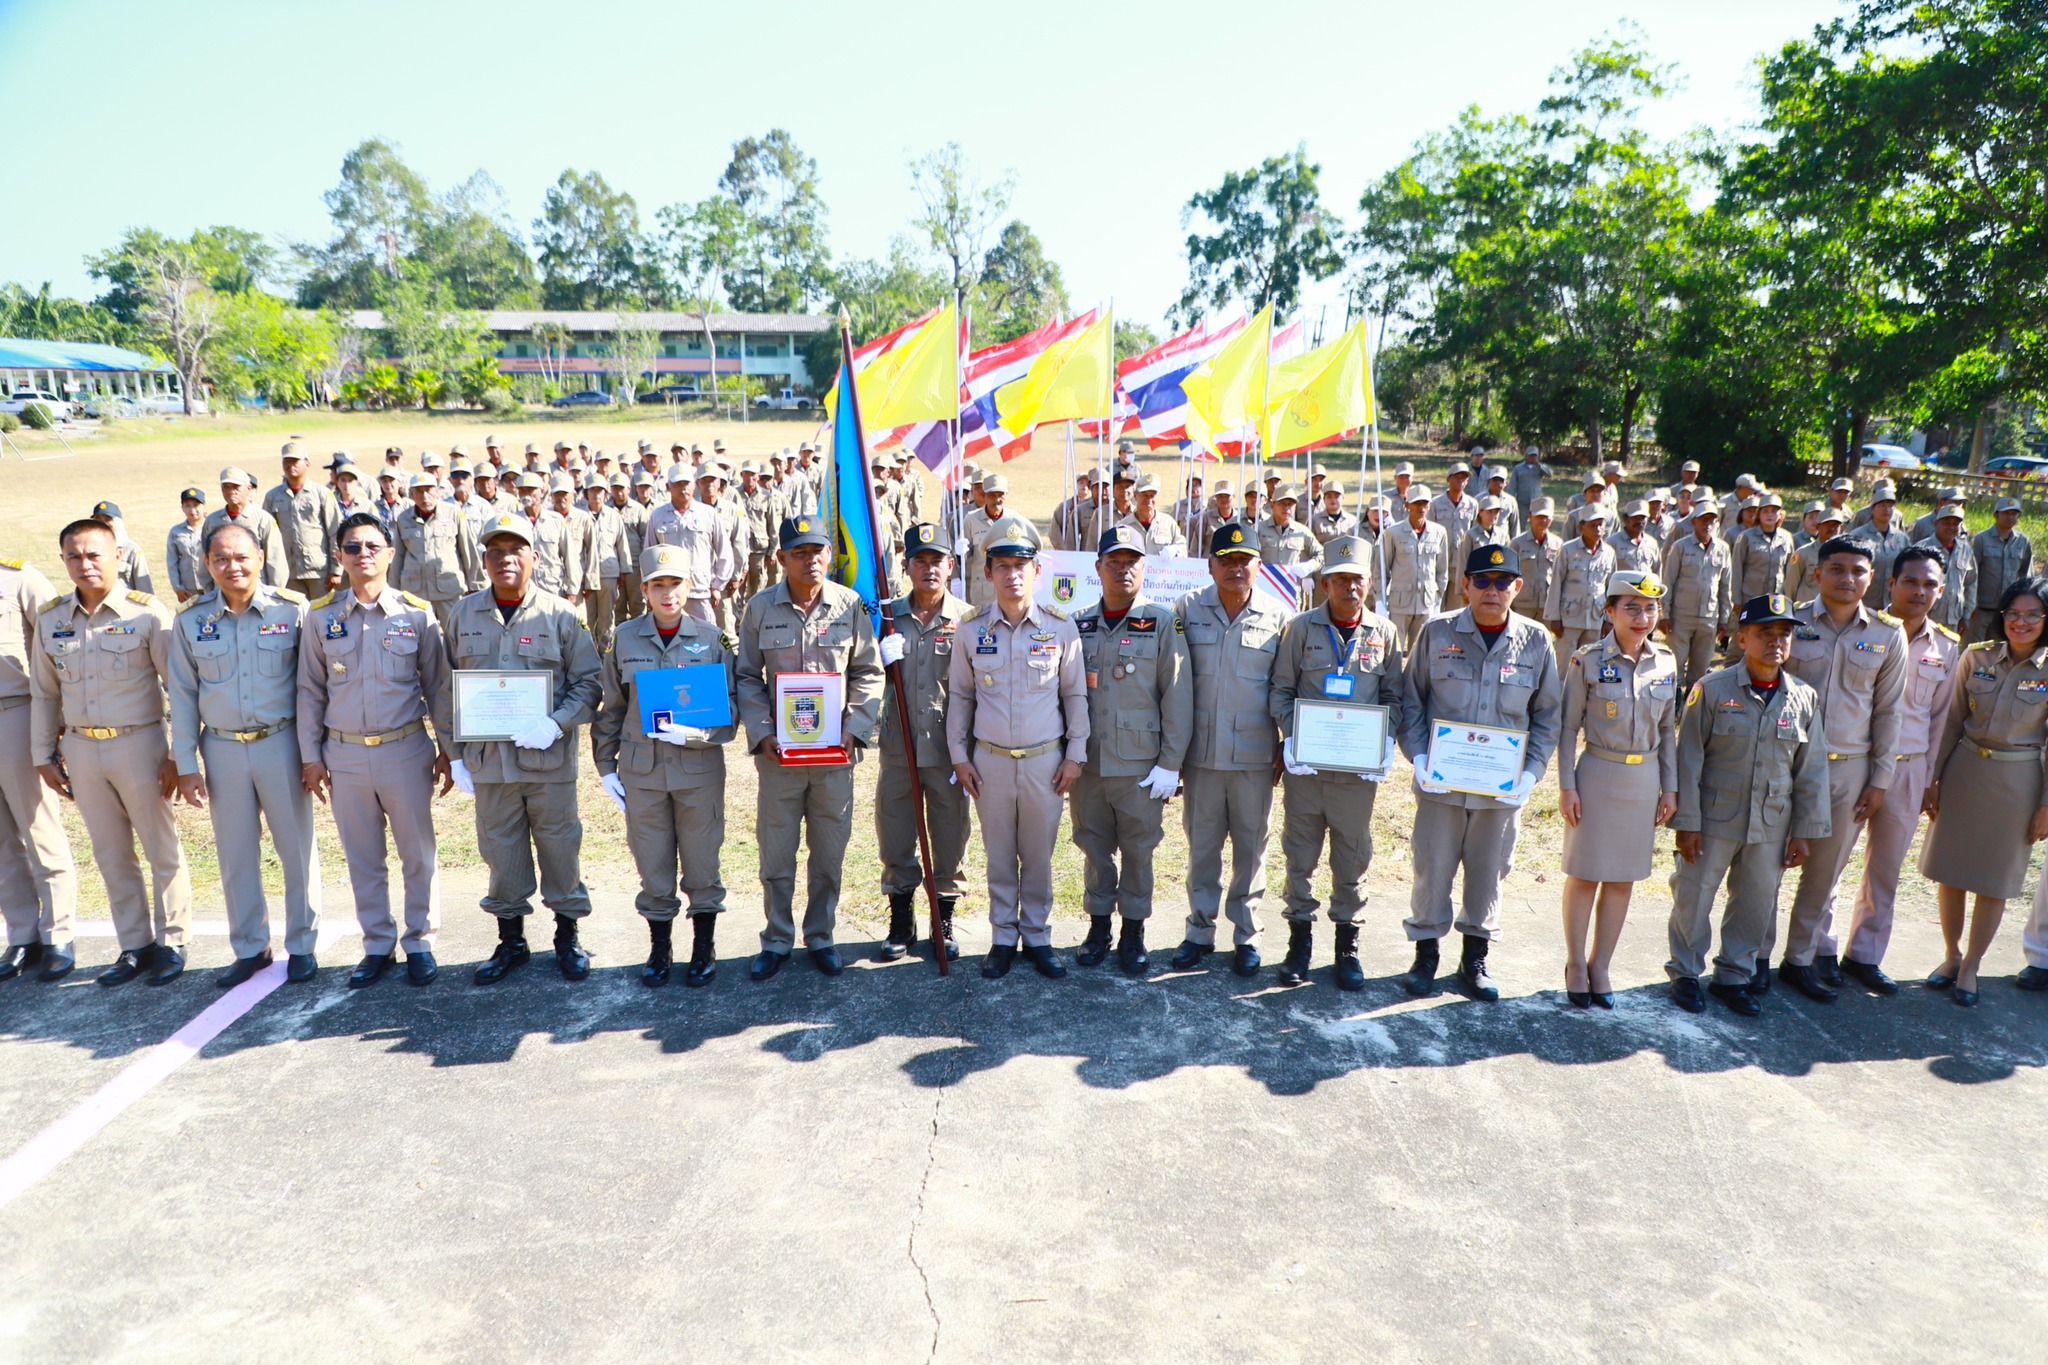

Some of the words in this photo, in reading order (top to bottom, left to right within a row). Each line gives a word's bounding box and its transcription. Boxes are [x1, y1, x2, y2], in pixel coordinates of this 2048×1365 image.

[1147, 565, 1172, 575] มีนาคม
[1175, 568, 1205, 579] ของทุกปี
